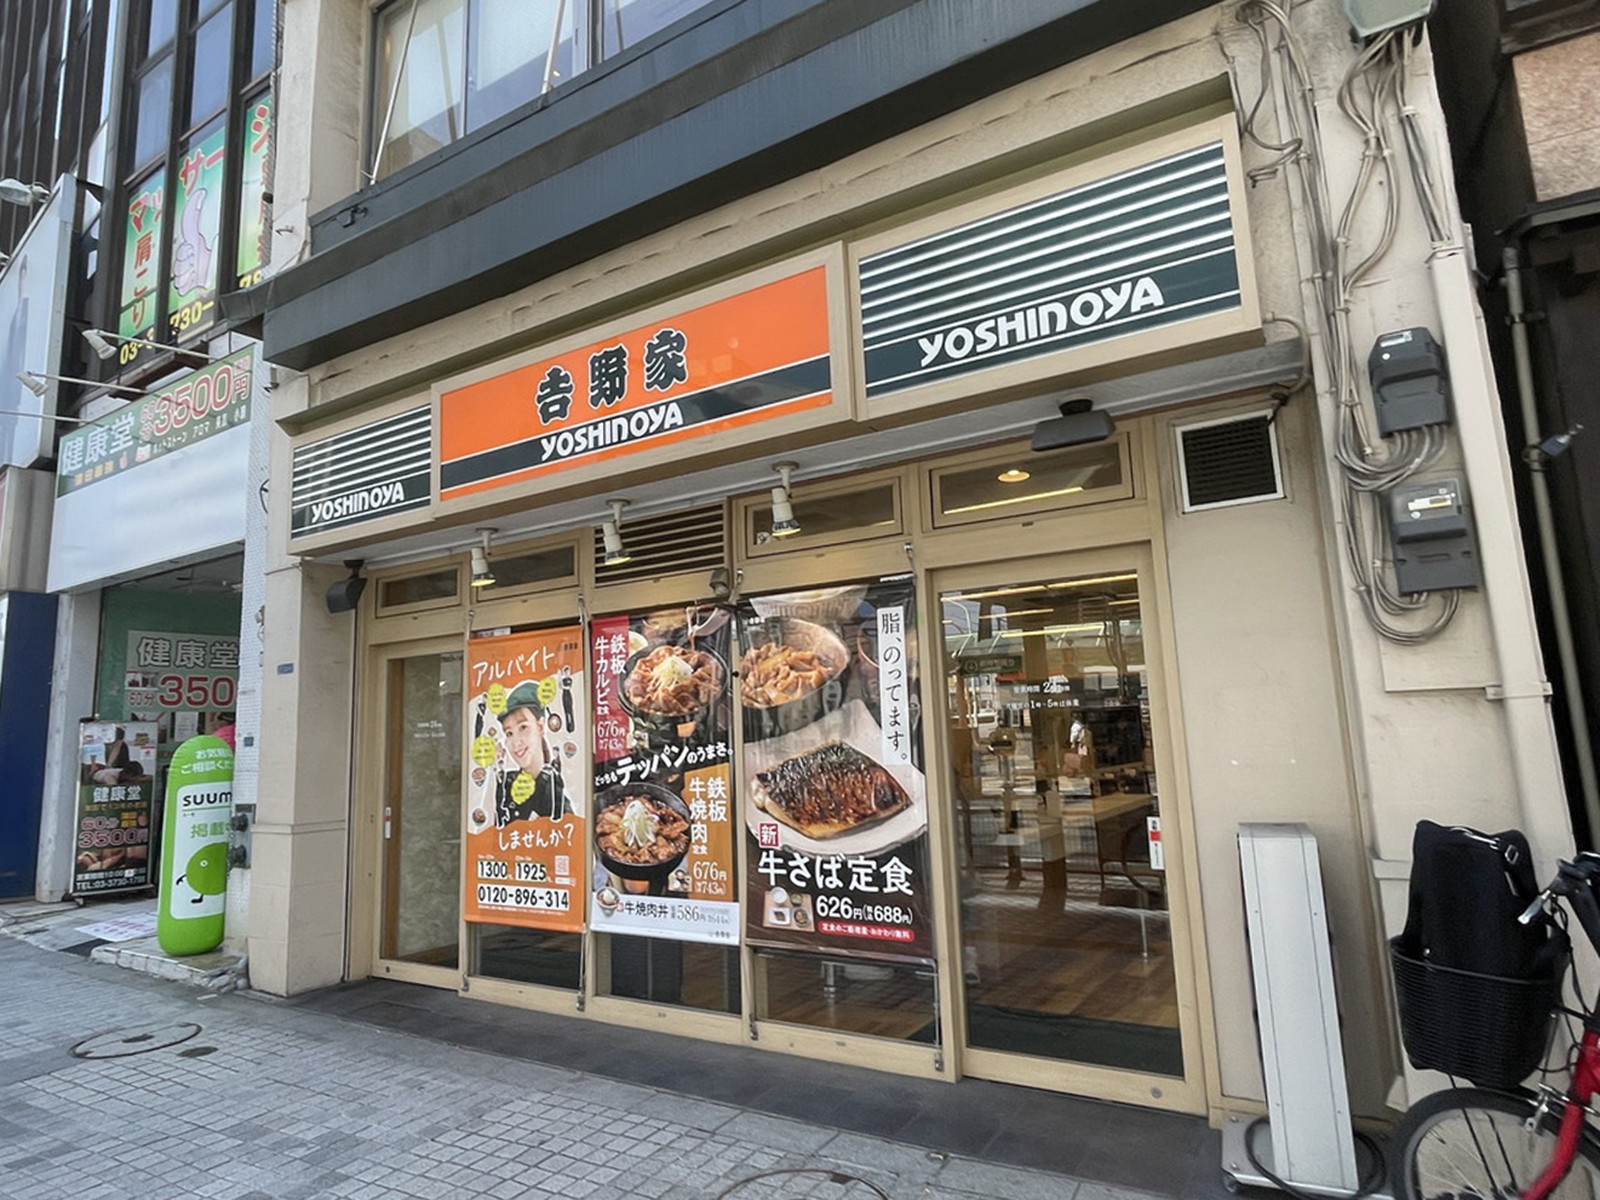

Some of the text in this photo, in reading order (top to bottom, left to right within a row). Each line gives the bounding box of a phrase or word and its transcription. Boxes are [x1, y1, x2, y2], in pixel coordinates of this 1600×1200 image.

[918, 277, 1165, 368] YOSHINOYA
[62, 411, 134, 476] 健康堂
[541, 402, 684, 462] YOSHINOYA
[311, 481, 405, 524] YOSHINOYA
[138, 636, 239, 669] 健康堂
[473, 645, 555, 688] アルバイト
[610, 634, 627, 675] 鉄板
[881, 612, 908, 761] 脂、のってます。
[597, 720, 626, 739] 676円
[93, 785, 141, 803] 健康堂
[707, 776, 728, 822] 鉄板
[760, 823, 779, 847] 新
[479, 861, 508, 878] 1300
[516, 863, 547, 881] 1925
[693, 860, 728, 881] 676円
[758, 850, 914, 896] 牛さば定食
[478, 885, 568, 909] 0120-896-314
[625, 902, 668, 918] 牛焼肉丼
